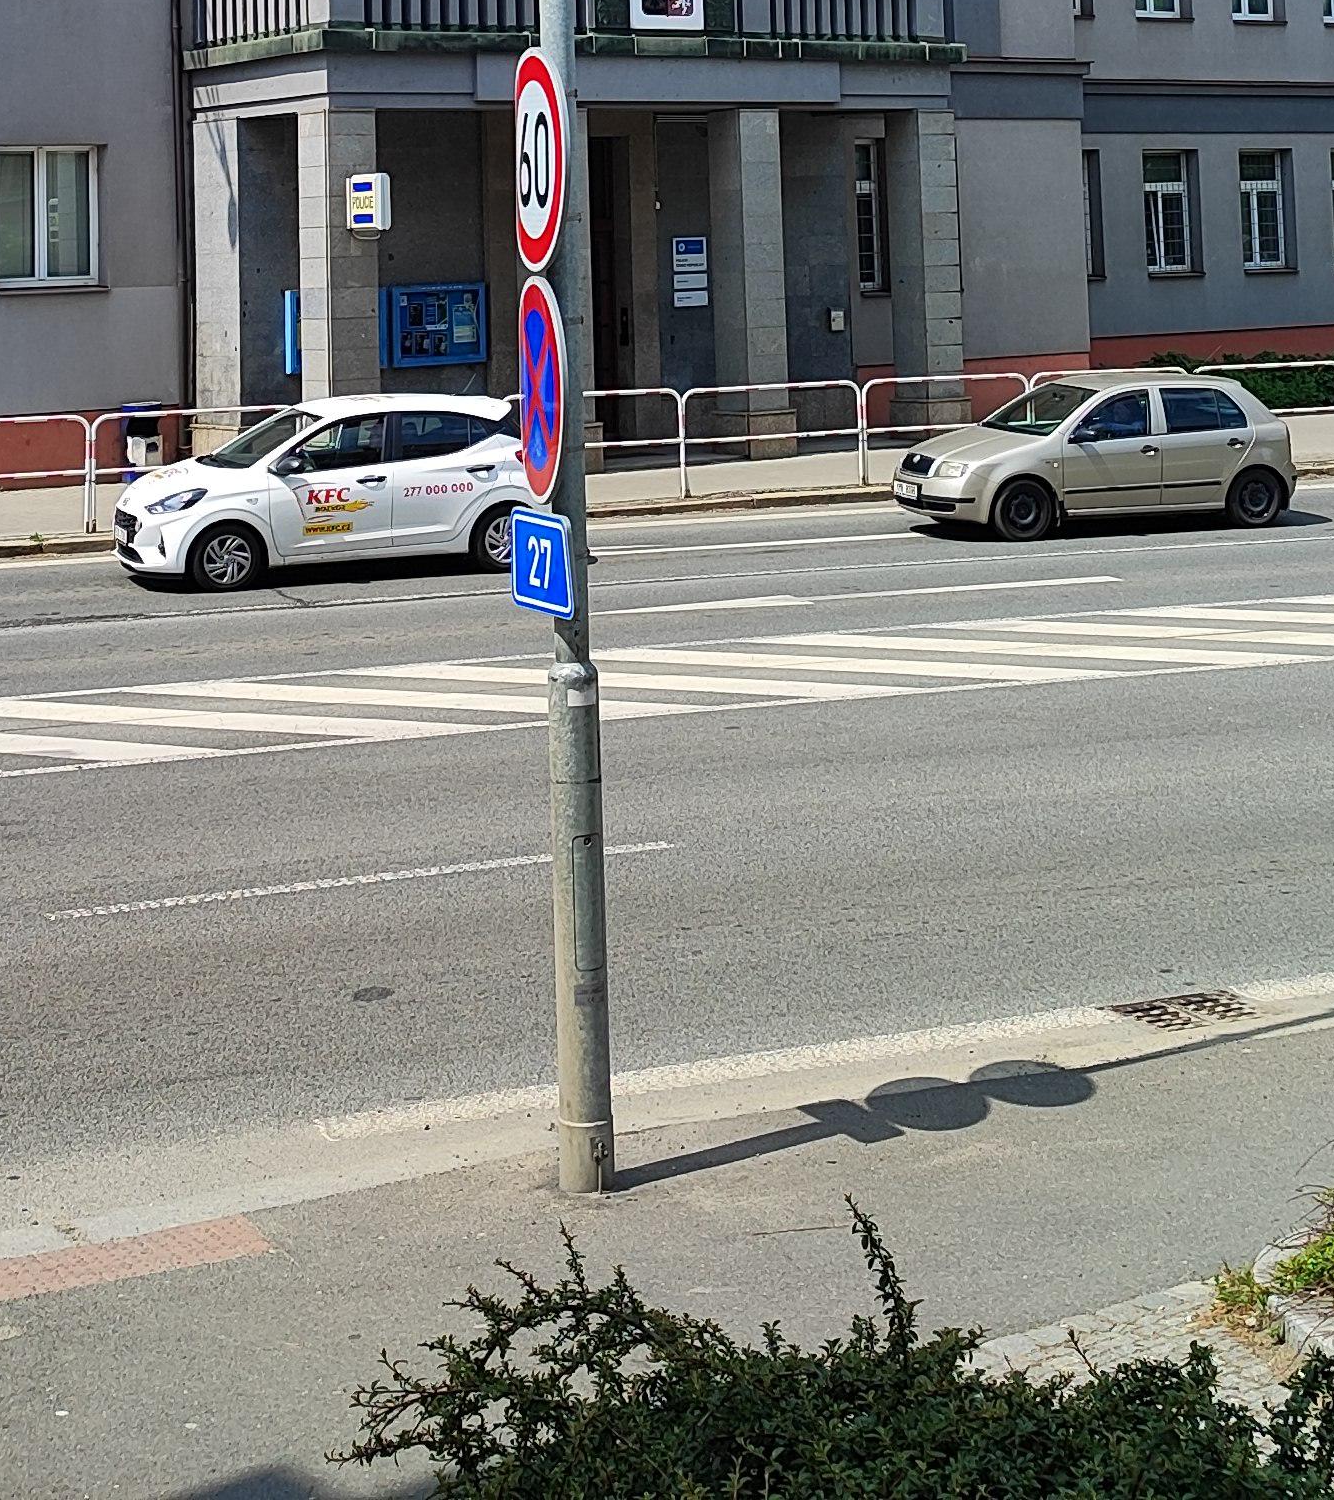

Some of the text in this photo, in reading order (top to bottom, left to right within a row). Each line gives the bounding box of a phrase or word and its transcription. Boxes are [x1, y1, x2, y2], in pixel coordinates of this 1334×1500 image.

[520, 111, 550, 209] 60
[306, 488, 351, 506] KFC
[403, 482, 474, 498] 277 000 000
[527, 535, 552, 590] 27
